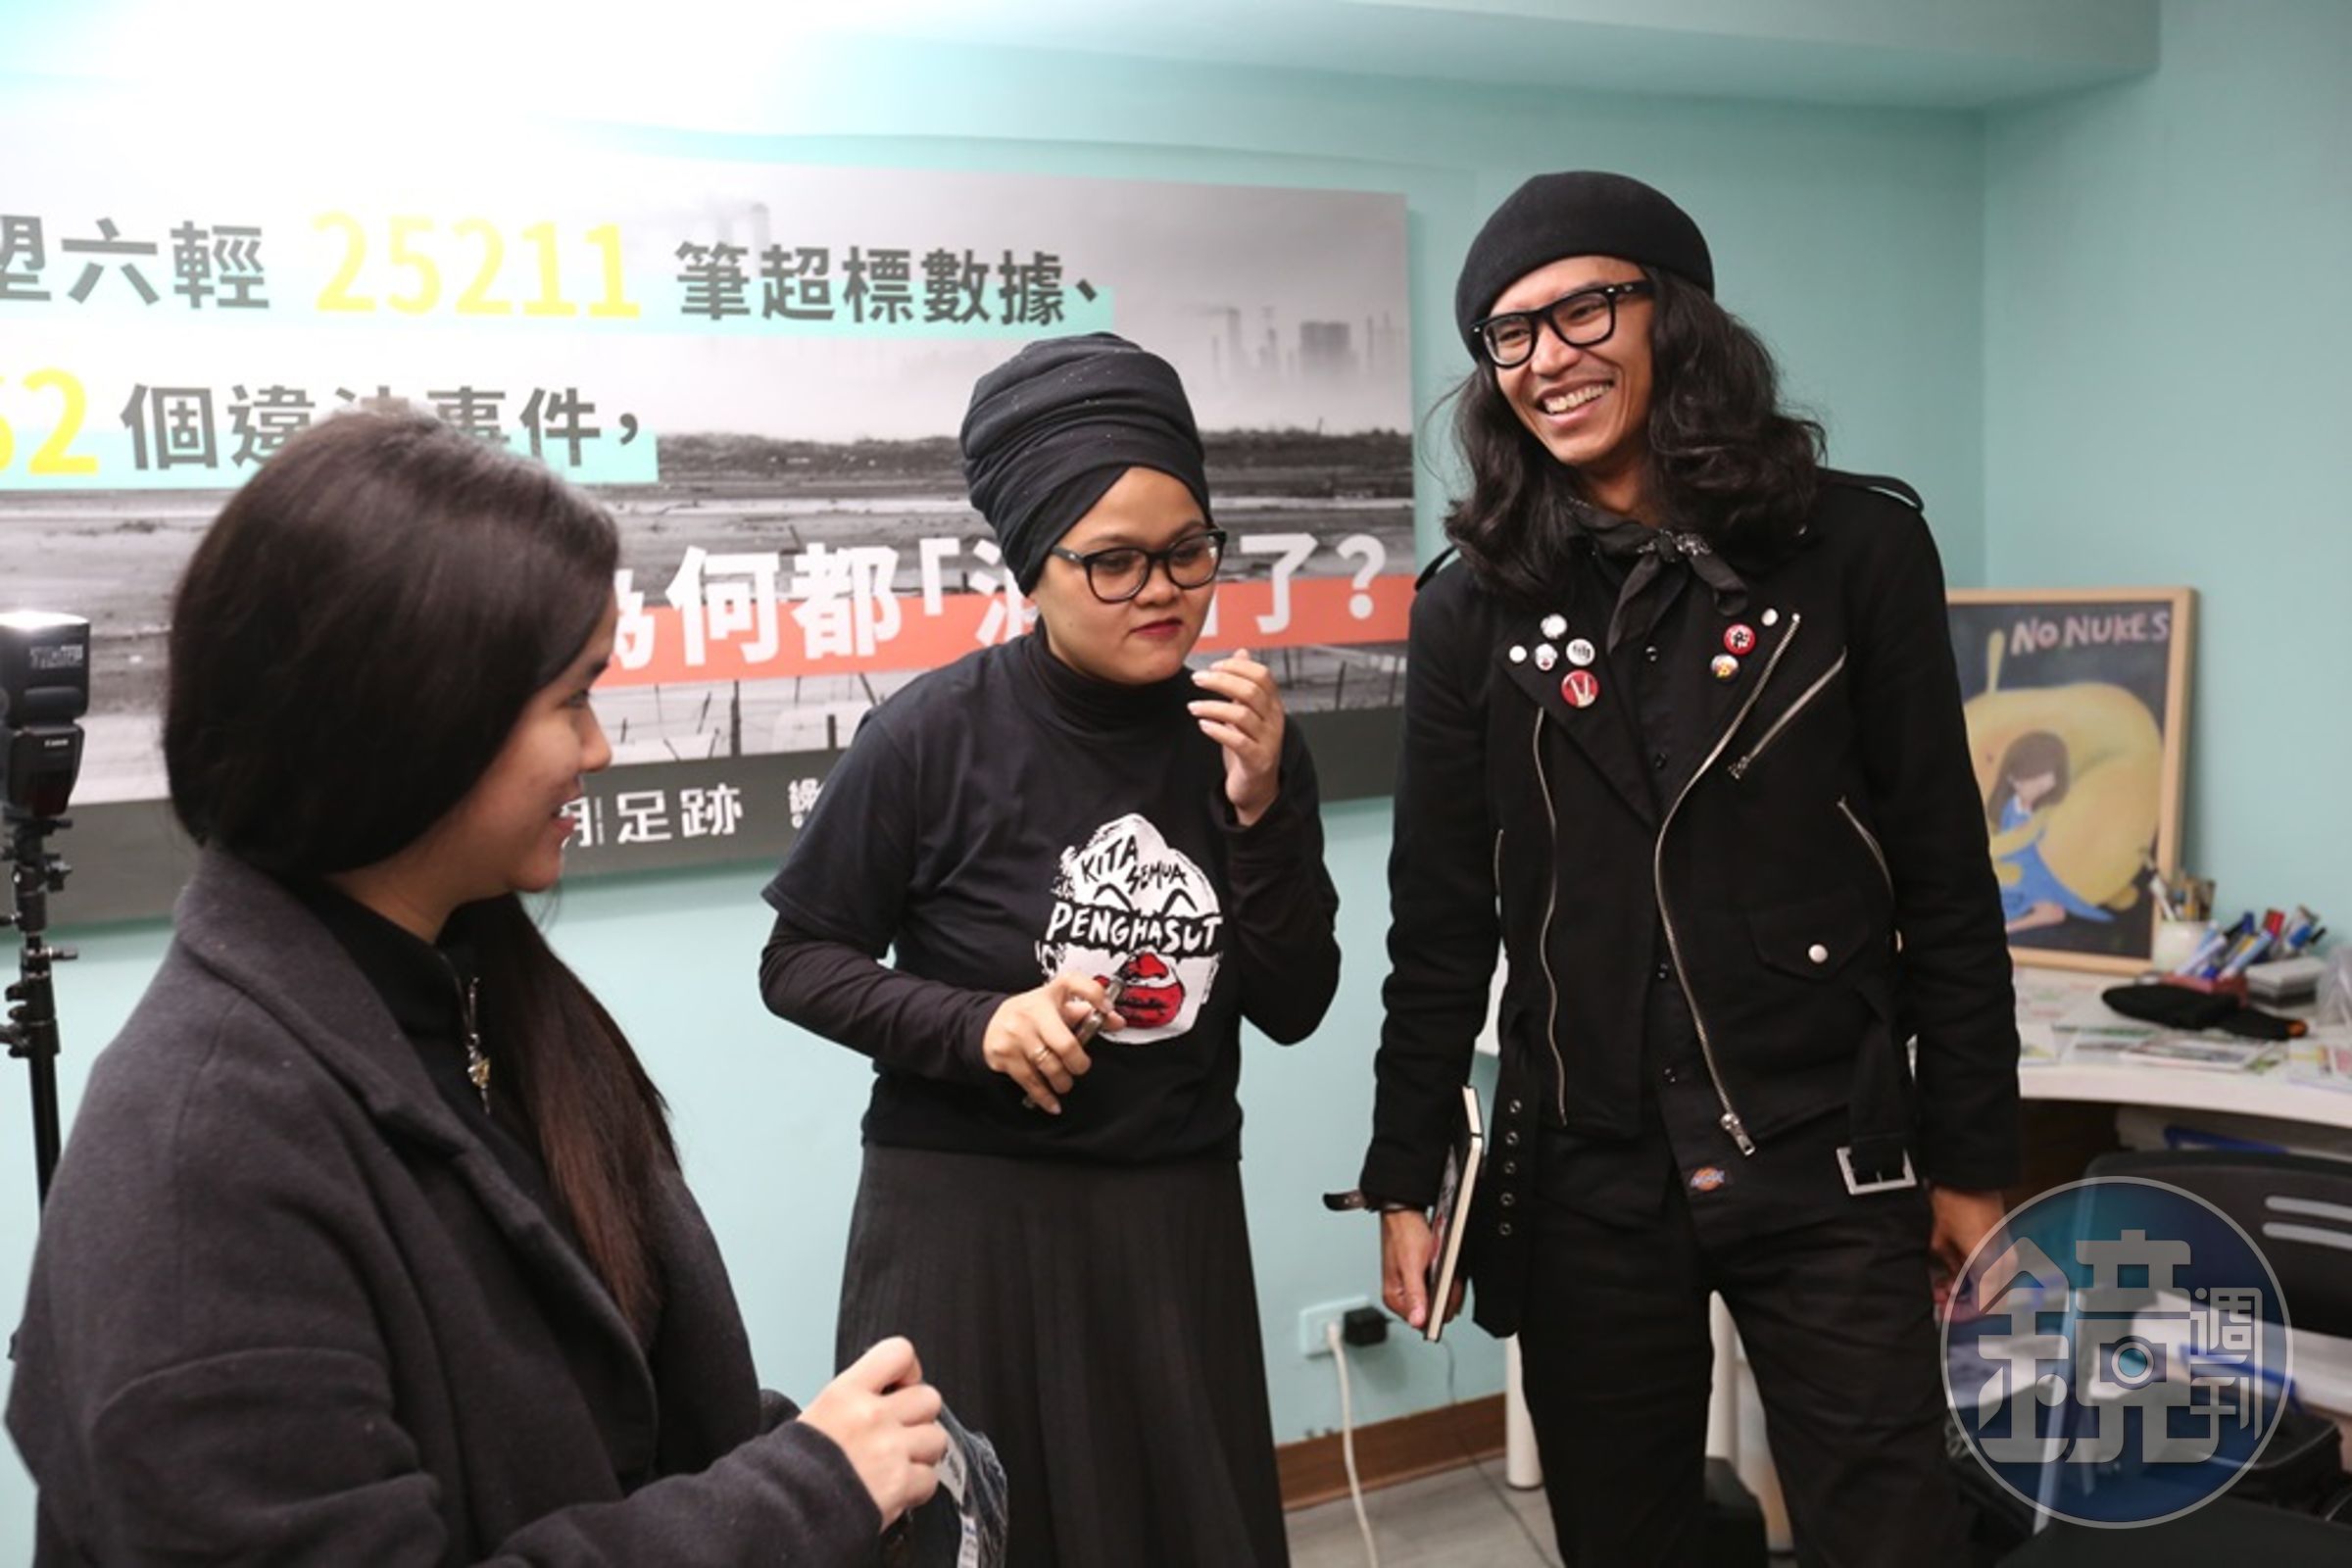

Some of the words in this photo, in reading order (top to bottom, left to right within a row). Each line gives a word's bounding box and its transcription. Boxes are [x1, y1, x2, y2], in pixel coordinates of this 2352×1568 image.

[312, 211, 641, 318] 25211
[0, 368, 99, 475] 2
[2063, 611, 2169, 649] NUKES
[1081, 835, 1139, 883] KITA
[1126, 861, 1188, 895] SEMUA
[1046, 902, 1223, 953] PENGHASUT
